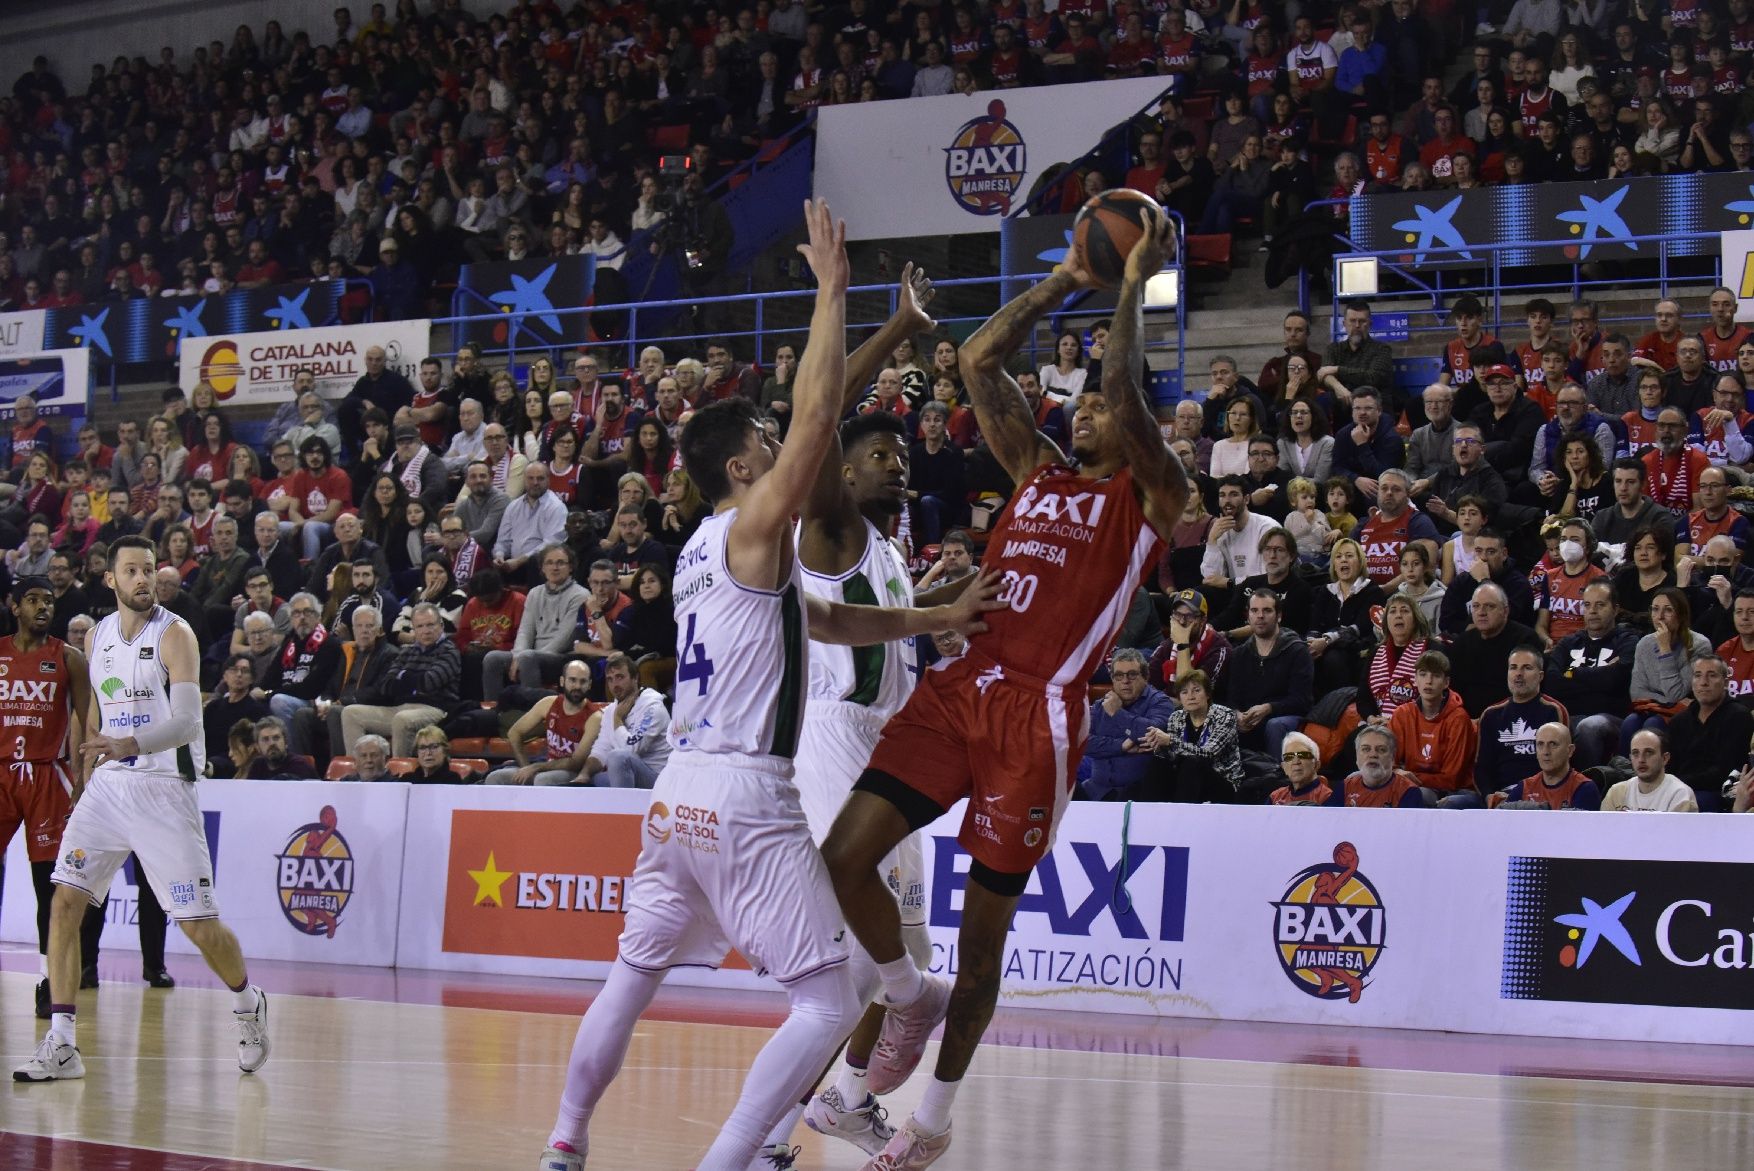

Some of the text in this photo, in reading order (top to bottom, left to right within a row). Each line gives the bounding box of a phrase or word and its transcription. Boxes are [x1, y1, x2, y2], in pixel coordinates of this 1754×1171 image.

[949, 144, 1024, 177] BAXI
[961, 178, 1011, 195] MANRESA
[250, 340, 357, 362] CATALANA
[250, 365, 273, 381] DE
[1014, 485, 1106, 527] BAXI
[1000, 540, 1067, 567] MANRESA
[676, 613, 714, 697] 4
[0, 680, 58, 702] BAXI
[125, 686, 154, 698] Uicaja
[1390, 685, 1413, 698] BAXI
[1727, 679, 1754, 698] BA
[3, 715, 43, 729] MANRESA
[13, 735, 26, 760] 3
[675, 804, 719, 826] COSTA
[675, 822, 719, 840] DEL SOL
[280, 857, 353, 890] BAXI
[290, 894, 338, 912] MANRESA
[1278, 905, 1383, 945] BAXI
[927, 943, 1183, 990] CLATIZACIÓN
[1296, 950, 1364, 971] MANRESA
